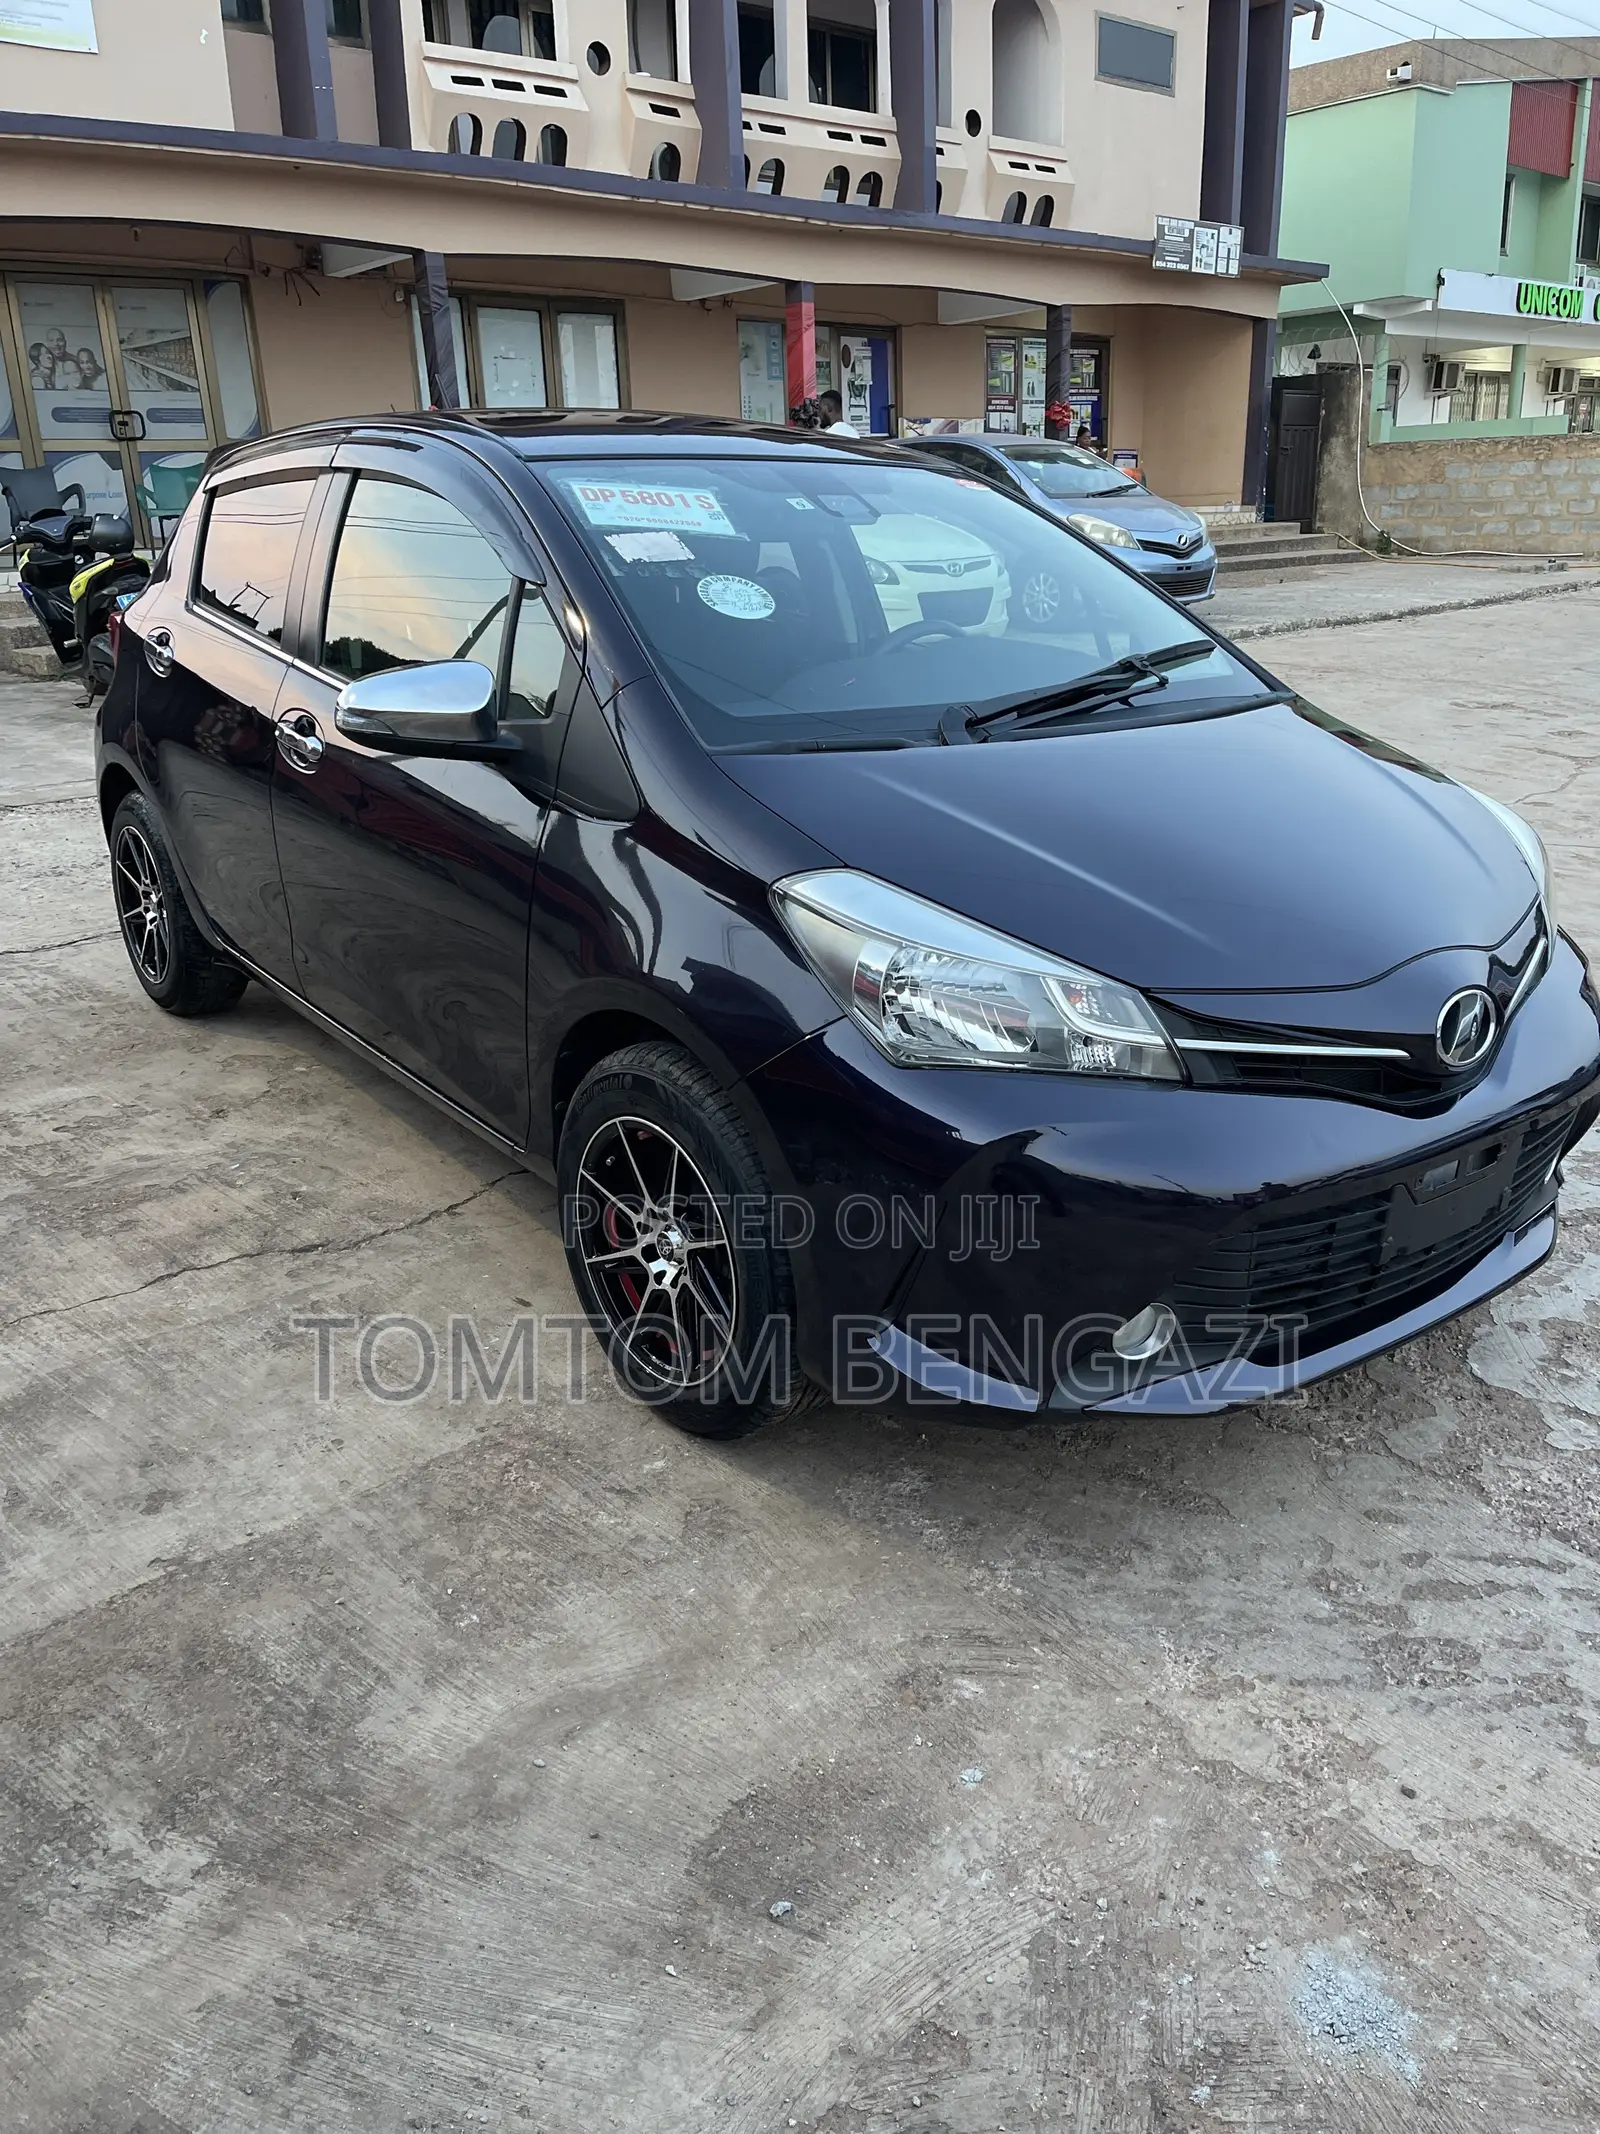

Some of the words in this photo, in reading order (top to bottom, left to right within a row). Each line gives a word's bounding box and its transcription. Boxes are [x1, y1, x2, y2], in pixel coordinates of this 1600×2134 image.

[1516, 282, 1584, 319] UNICOM
[578, 487, 616, 503] DP
[619, 489, 692, 508] 5801
[695, 494, 715, 510] S
[710, 576, 756, 588] COMPANY
